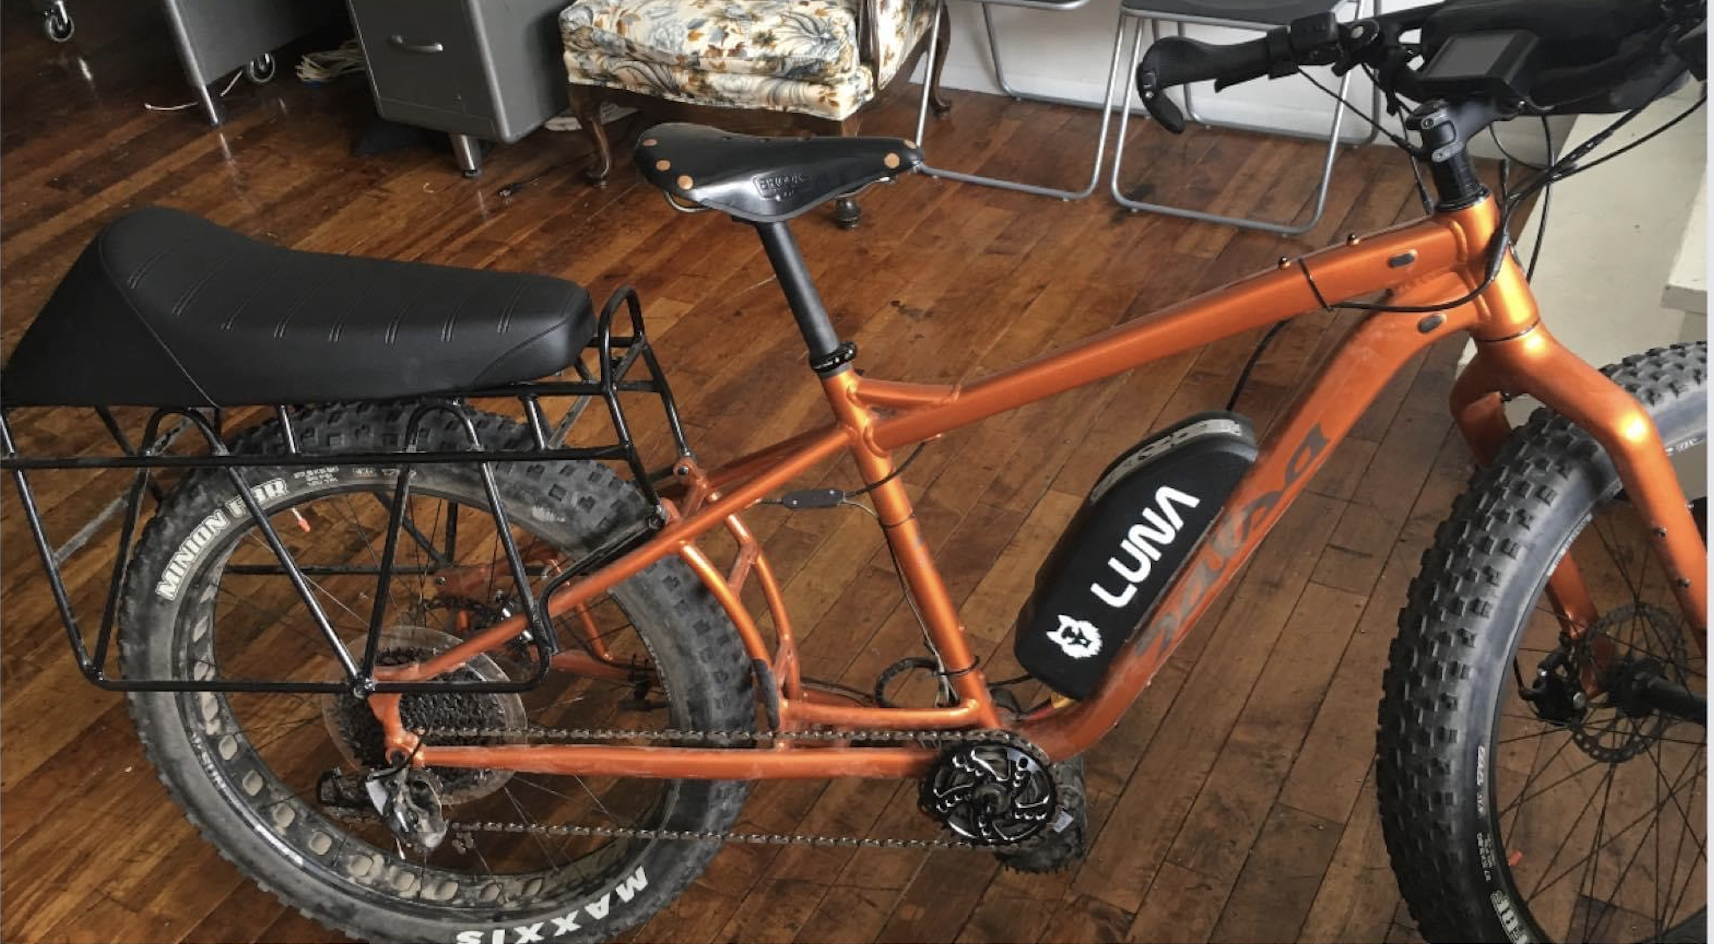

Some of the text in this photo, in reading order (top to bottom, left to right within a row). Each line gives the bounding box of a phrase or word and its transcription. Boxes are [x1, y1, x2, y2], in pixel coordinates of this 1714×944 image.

[155, 509, 231, 600] MINION
[1090, 486, 1200, 608] LUNA
[456, 865, 649, 944] MAXXIS
